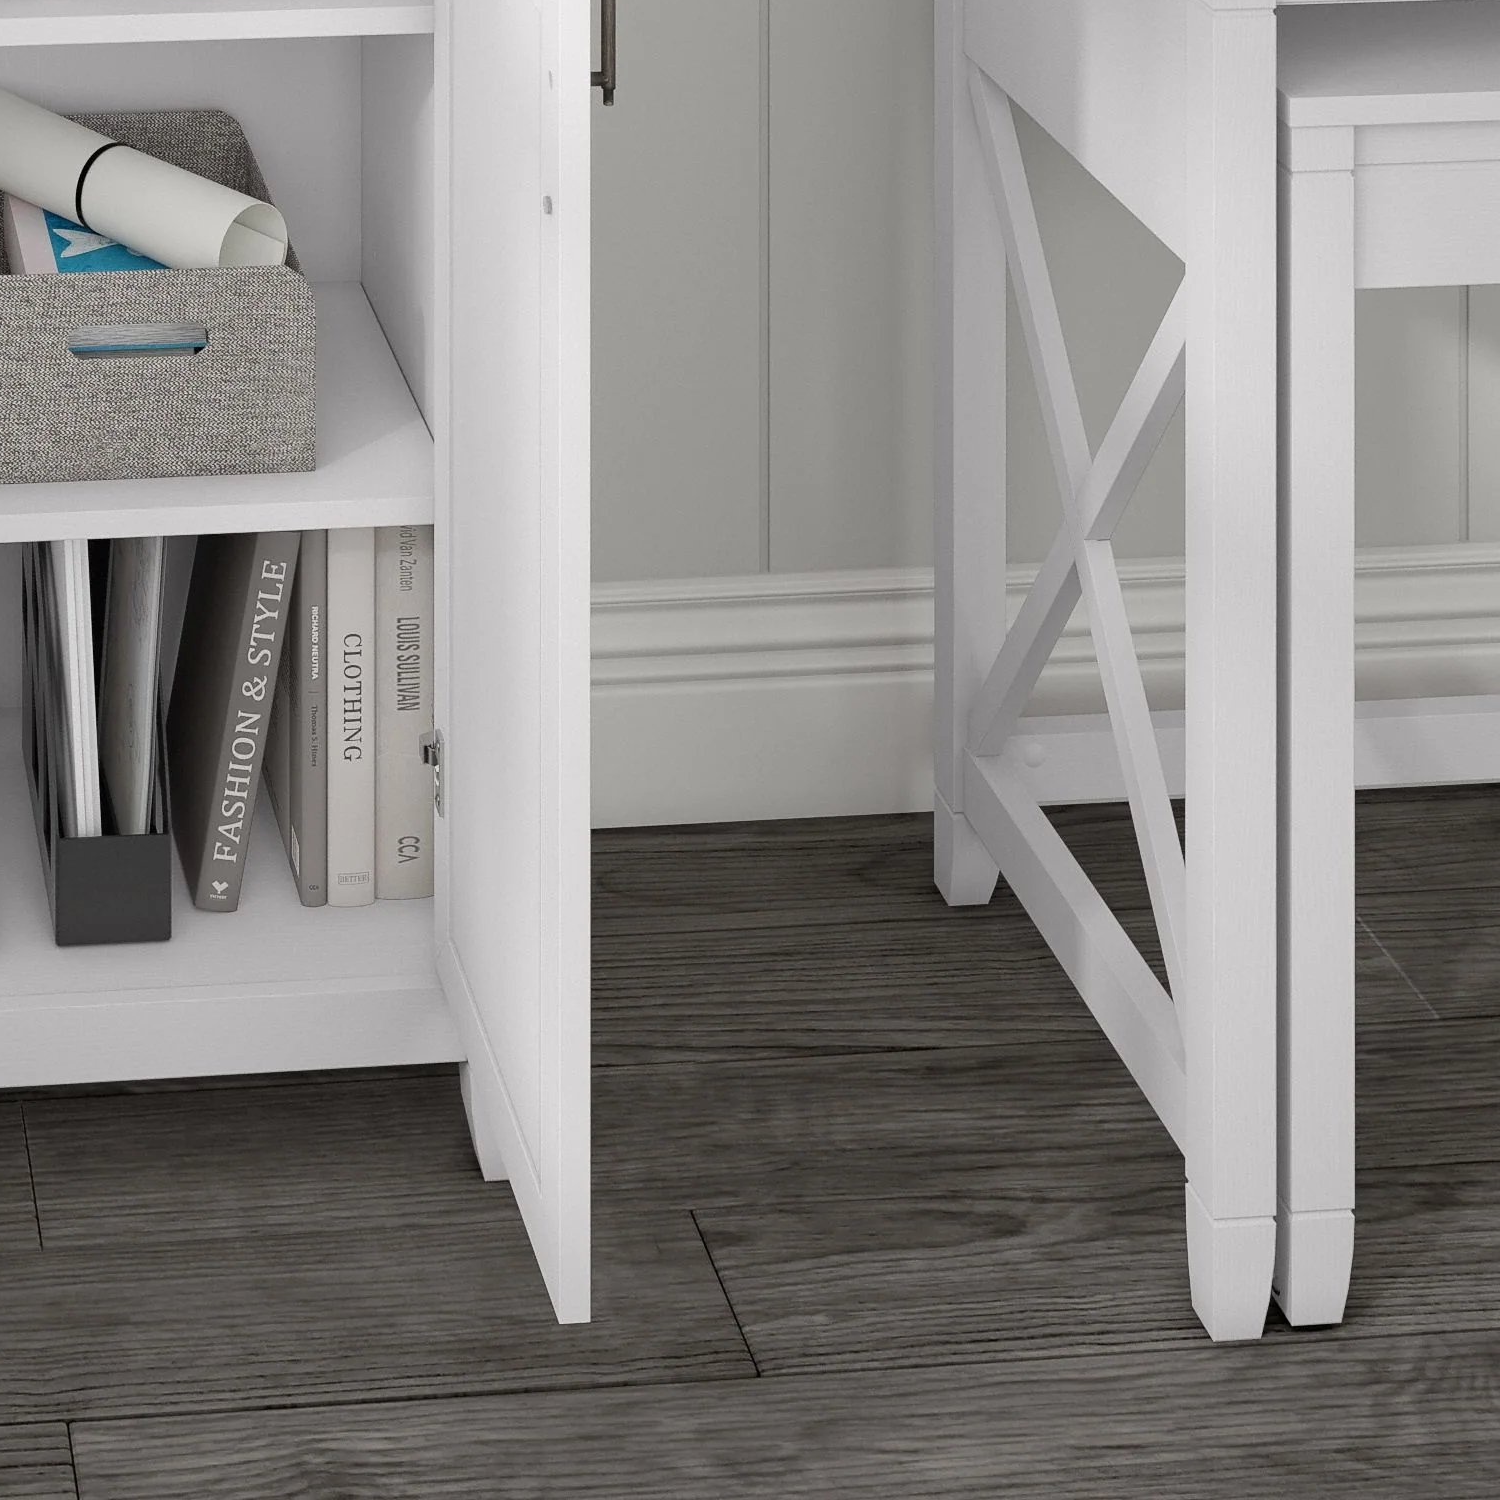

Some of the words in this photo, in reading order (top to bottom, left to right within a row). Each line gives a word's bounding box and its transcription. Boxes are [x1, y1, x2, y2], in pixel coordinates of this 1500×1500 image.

[400, 539, 417, 557] Van
[400, 559, 417, 592] Zanten
[249, 560, 288, 668] STYLE
[311, 606, 319, 643] RICHARD
[396, 617, 420, 651] LOUIS
[311, 645, 319, 680] NEUTRA
[241, 674, 268, 701] &
[343, 633, 363, 761] CLOTHING
[396, 655, 420, 711] SULLIVAN
[212, 711, 261, 863] FASHION
